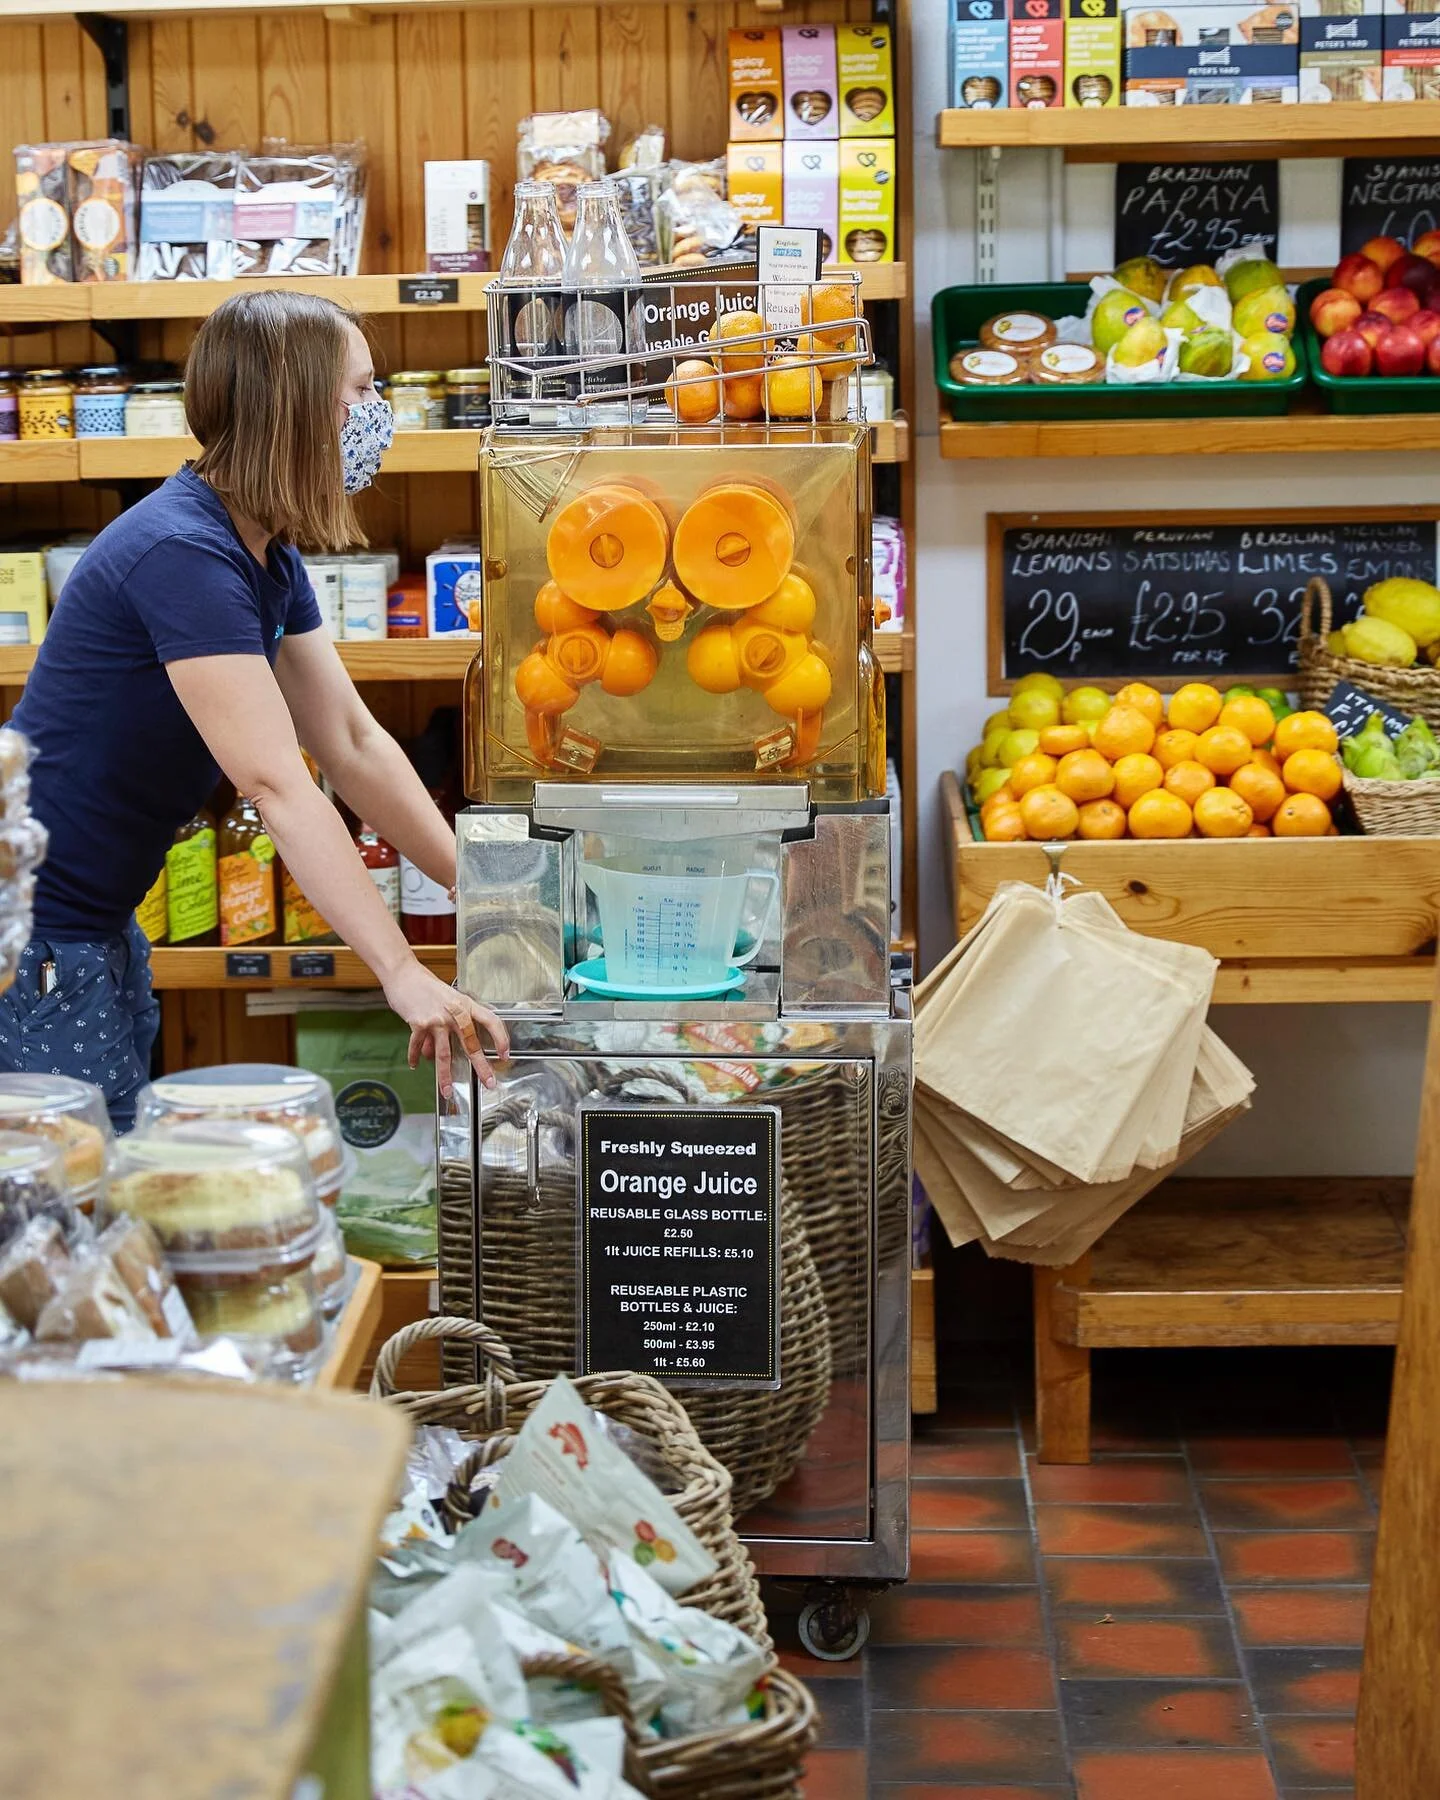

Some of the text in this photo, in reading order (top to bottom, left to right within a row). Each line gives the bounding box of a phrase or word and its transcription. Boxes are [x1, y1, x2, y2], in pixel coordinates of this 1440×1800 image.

[1188, 66, 1241, 75] PETER'S YARD
[1148, 164, 1252, 182] BRAZILIAN
[1121, 184, 1270, 214] PAPAYA
[1147, 210, 1241, 264] £2.95
[644, 292, 757, 324] Orange Juic
[766, 302, 800, 313] Reusab
[645, 333, 693, 352] usable
[1016, 532, 1109, 550] SPANISH
[1133, 530, 1214, 542] PERUVIAN
[1240, 530, 1336, 549] BRAZILIAN
[1012, 551, 1112, 577] LEMONS
[1123, 550, 1230, 573] SATSUMAS
[1238, 552, 1338, 574] LIMES
[1130, 580, 1225, 650] £2.95
[600, 1141, 756, 1157] Freshly Squeezed
[600, 1169, 757, 1199] Orange Juice
[590, 1208, 767, 1221] REUSABLE GLASS BOTTLE:
[664, 1228, 693, 1238] £2.50
[605, 1246, 754, 1259] 1lt JUICE REFILLS: £5.10
[610, 1285, 747, 1297] REUSEABLE PLASTIC
[620, 1302, 737, 1314] BOTTLES & JUICE:
[643, 1321, 676, 1331] 250ml
[685, 1322, 715, 1331] £2.10
[643, 1340, 676, 1349] 500ml
[685, 1340, 715, 1350] £3.95
[653, 1357, 666, 1367] 1lt
[676, 1358, 705, 1367] £5.60
